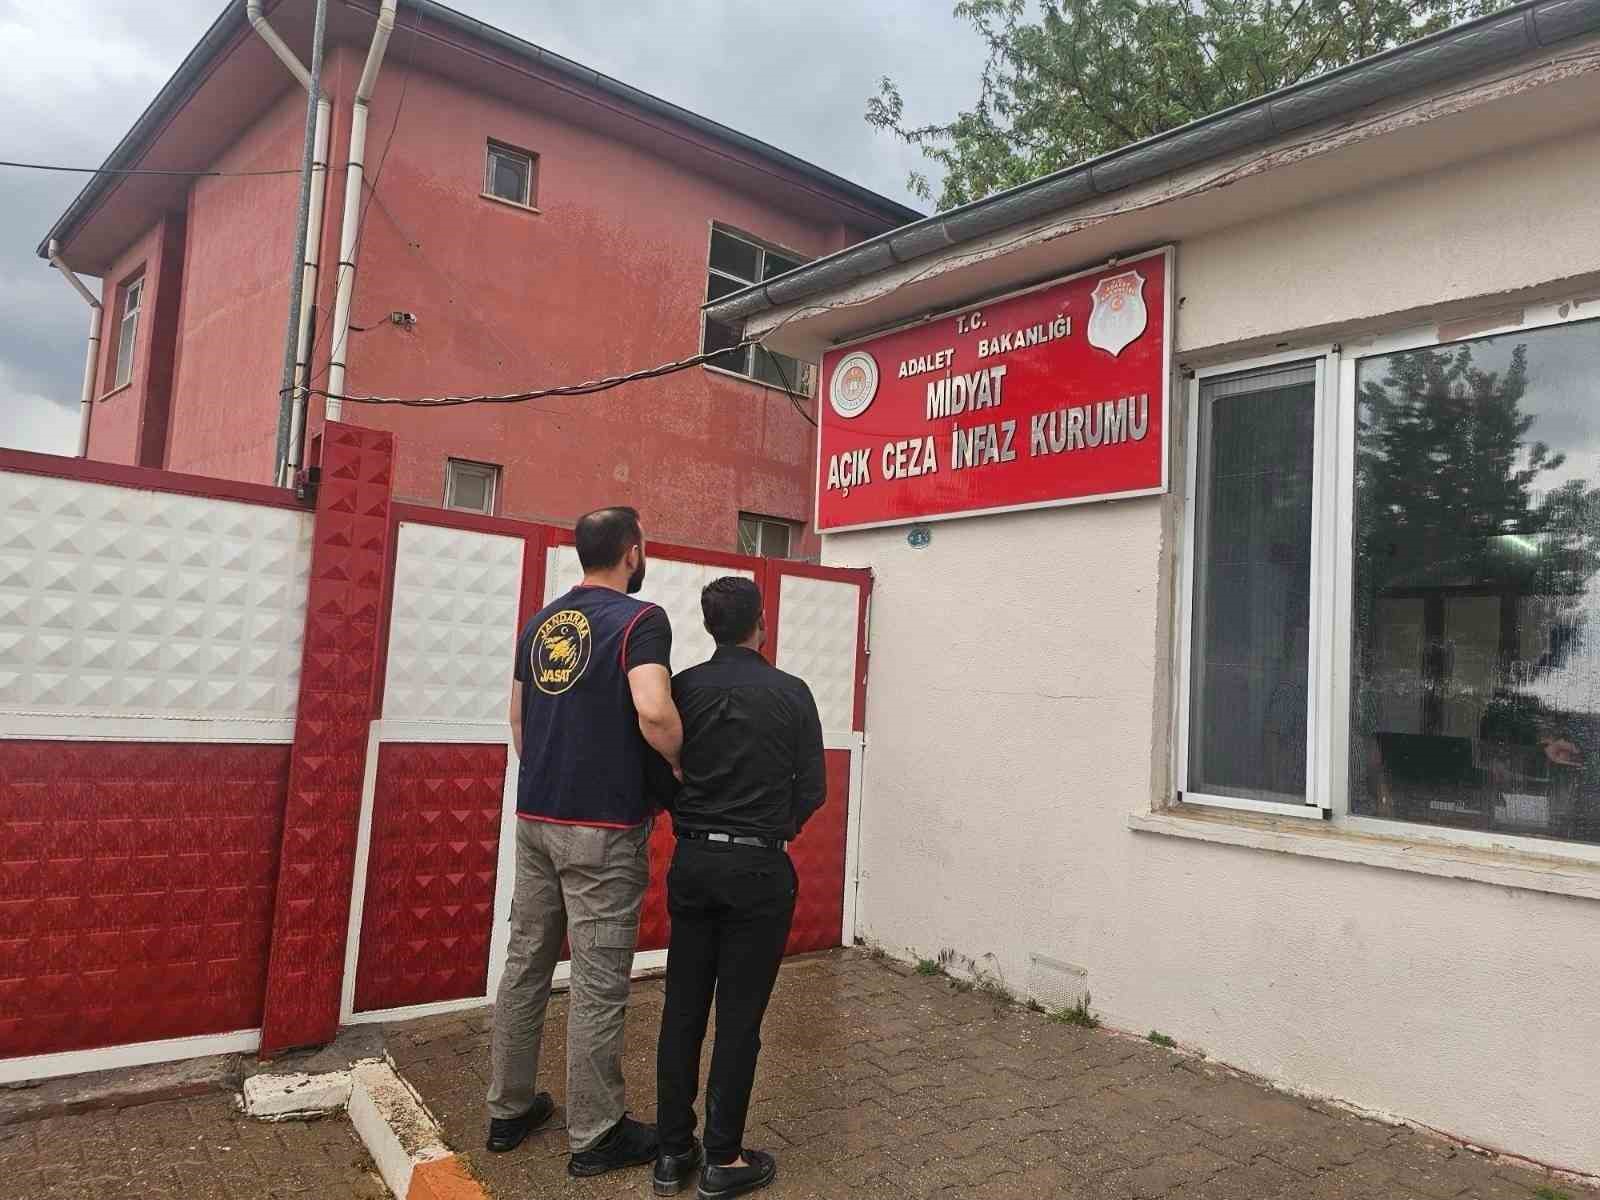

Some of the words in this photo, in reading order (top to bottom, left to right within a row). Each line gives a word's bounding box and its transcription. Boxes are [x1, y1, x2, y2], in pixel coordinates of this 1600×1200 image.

[956, 313, 987, 334] T.C.
[899, 348, 955, 378] ADALET
[978, 313, 1072, 359] BAKANLIĞI
[926, 365, 1007, 420] MİDYAT
[827, 448, 871, 497] AÇIK
[882, 436, 938, 480] CEZA
[951, 420, 1016, 470] İNFAZ
[1030, 394, 1148, 457] KURUMU
[540, 613, 590, 639] JANDARMA
[540, 669, 571, 682] JASAT
